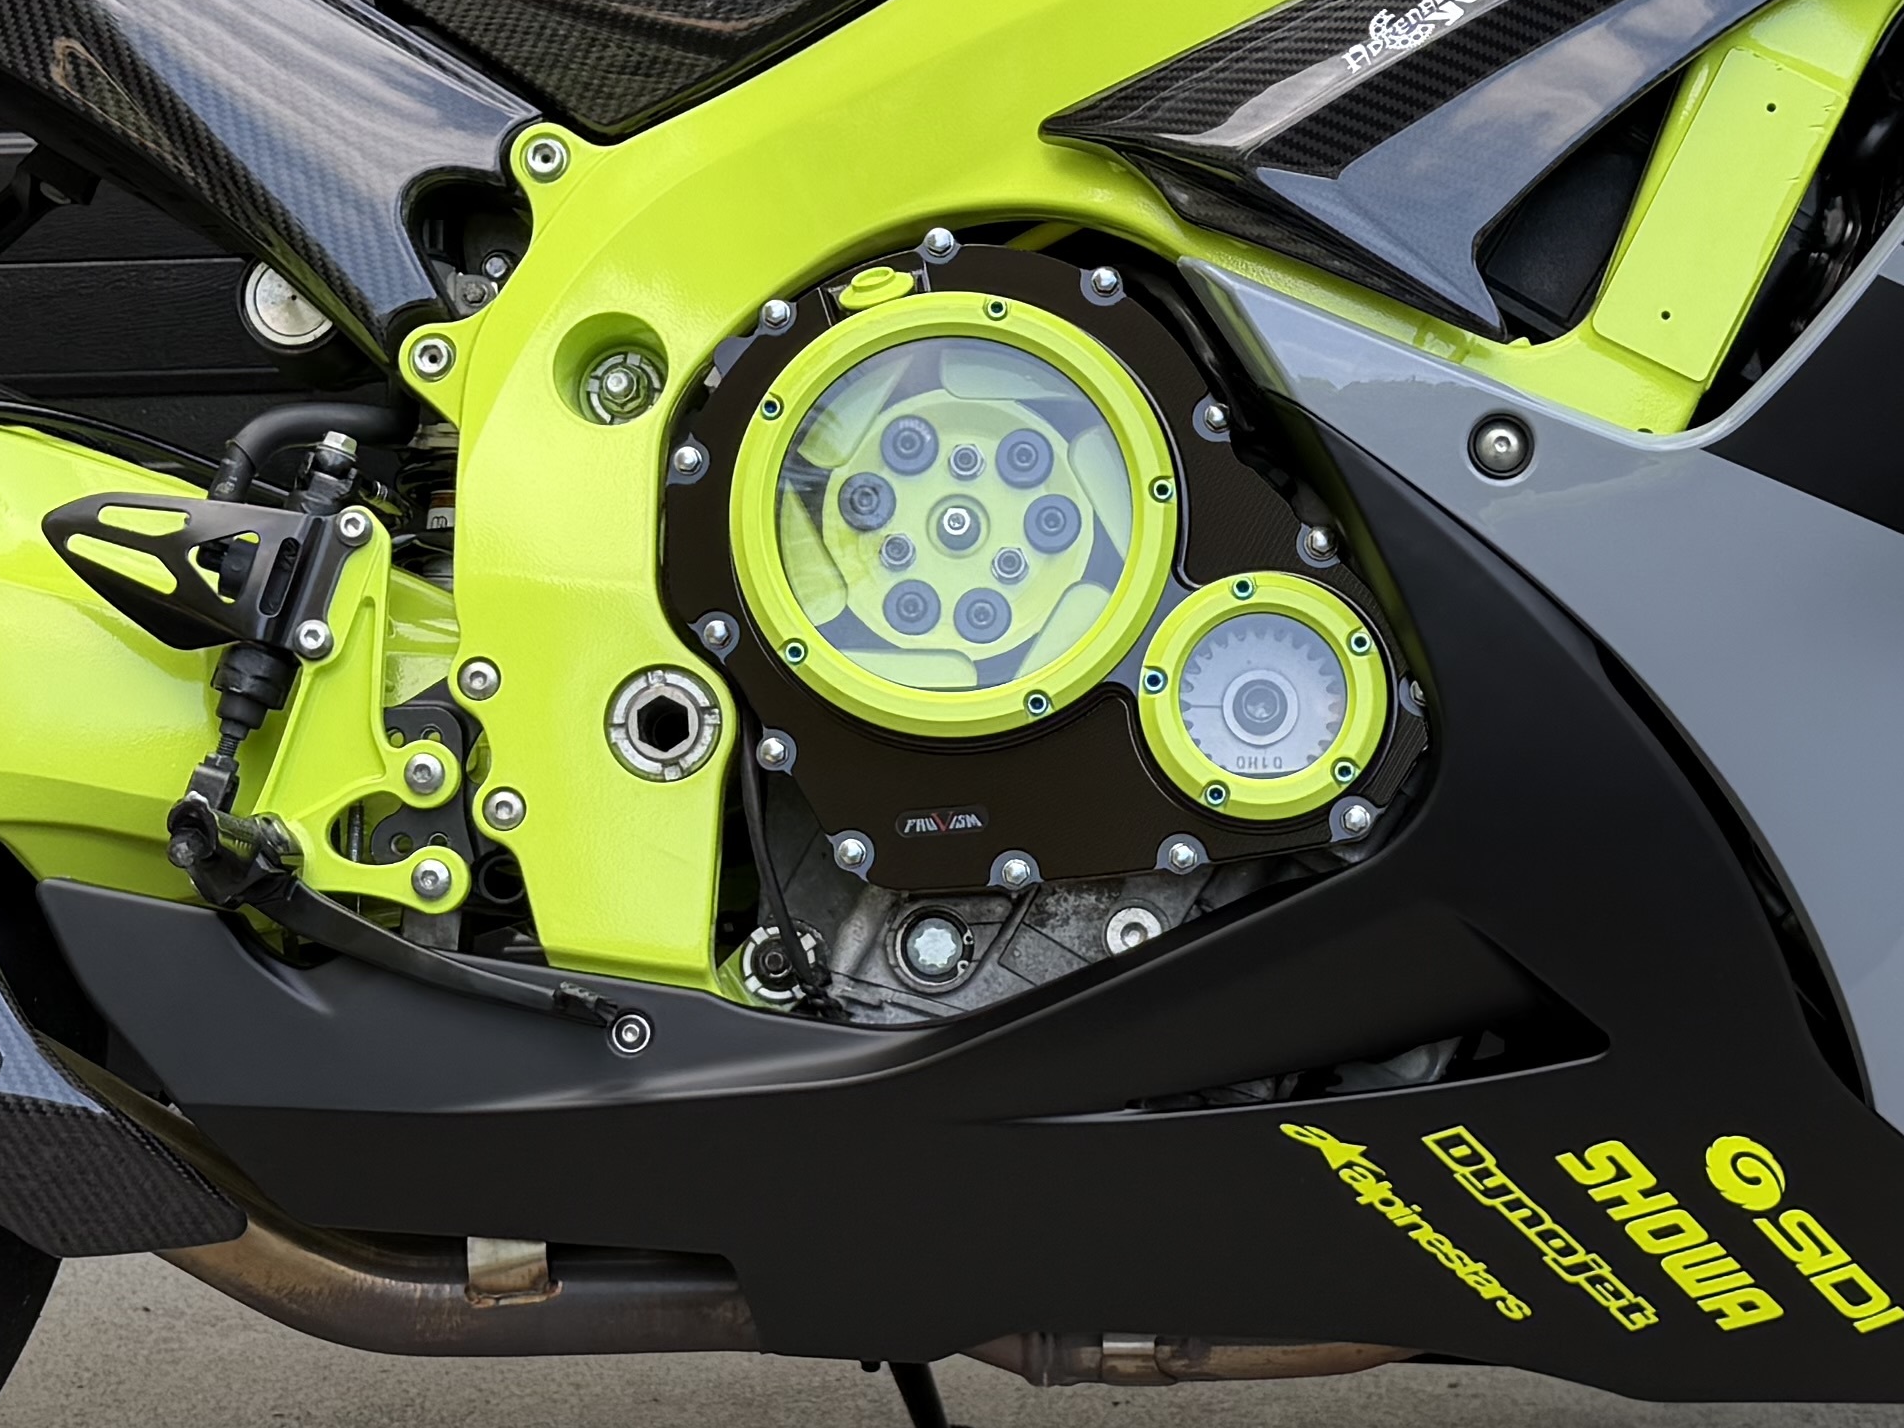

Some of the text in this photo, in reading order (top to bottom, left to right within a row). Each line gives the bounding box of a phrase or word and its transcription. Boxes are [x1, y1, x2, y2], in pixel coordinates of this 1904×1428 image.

[1328, 1152, 1533, 1322] alpinestars
[1422, 1125, 1659, 1332] Dynojet
[1555, 1139, 1786, 1332] SHOWA
